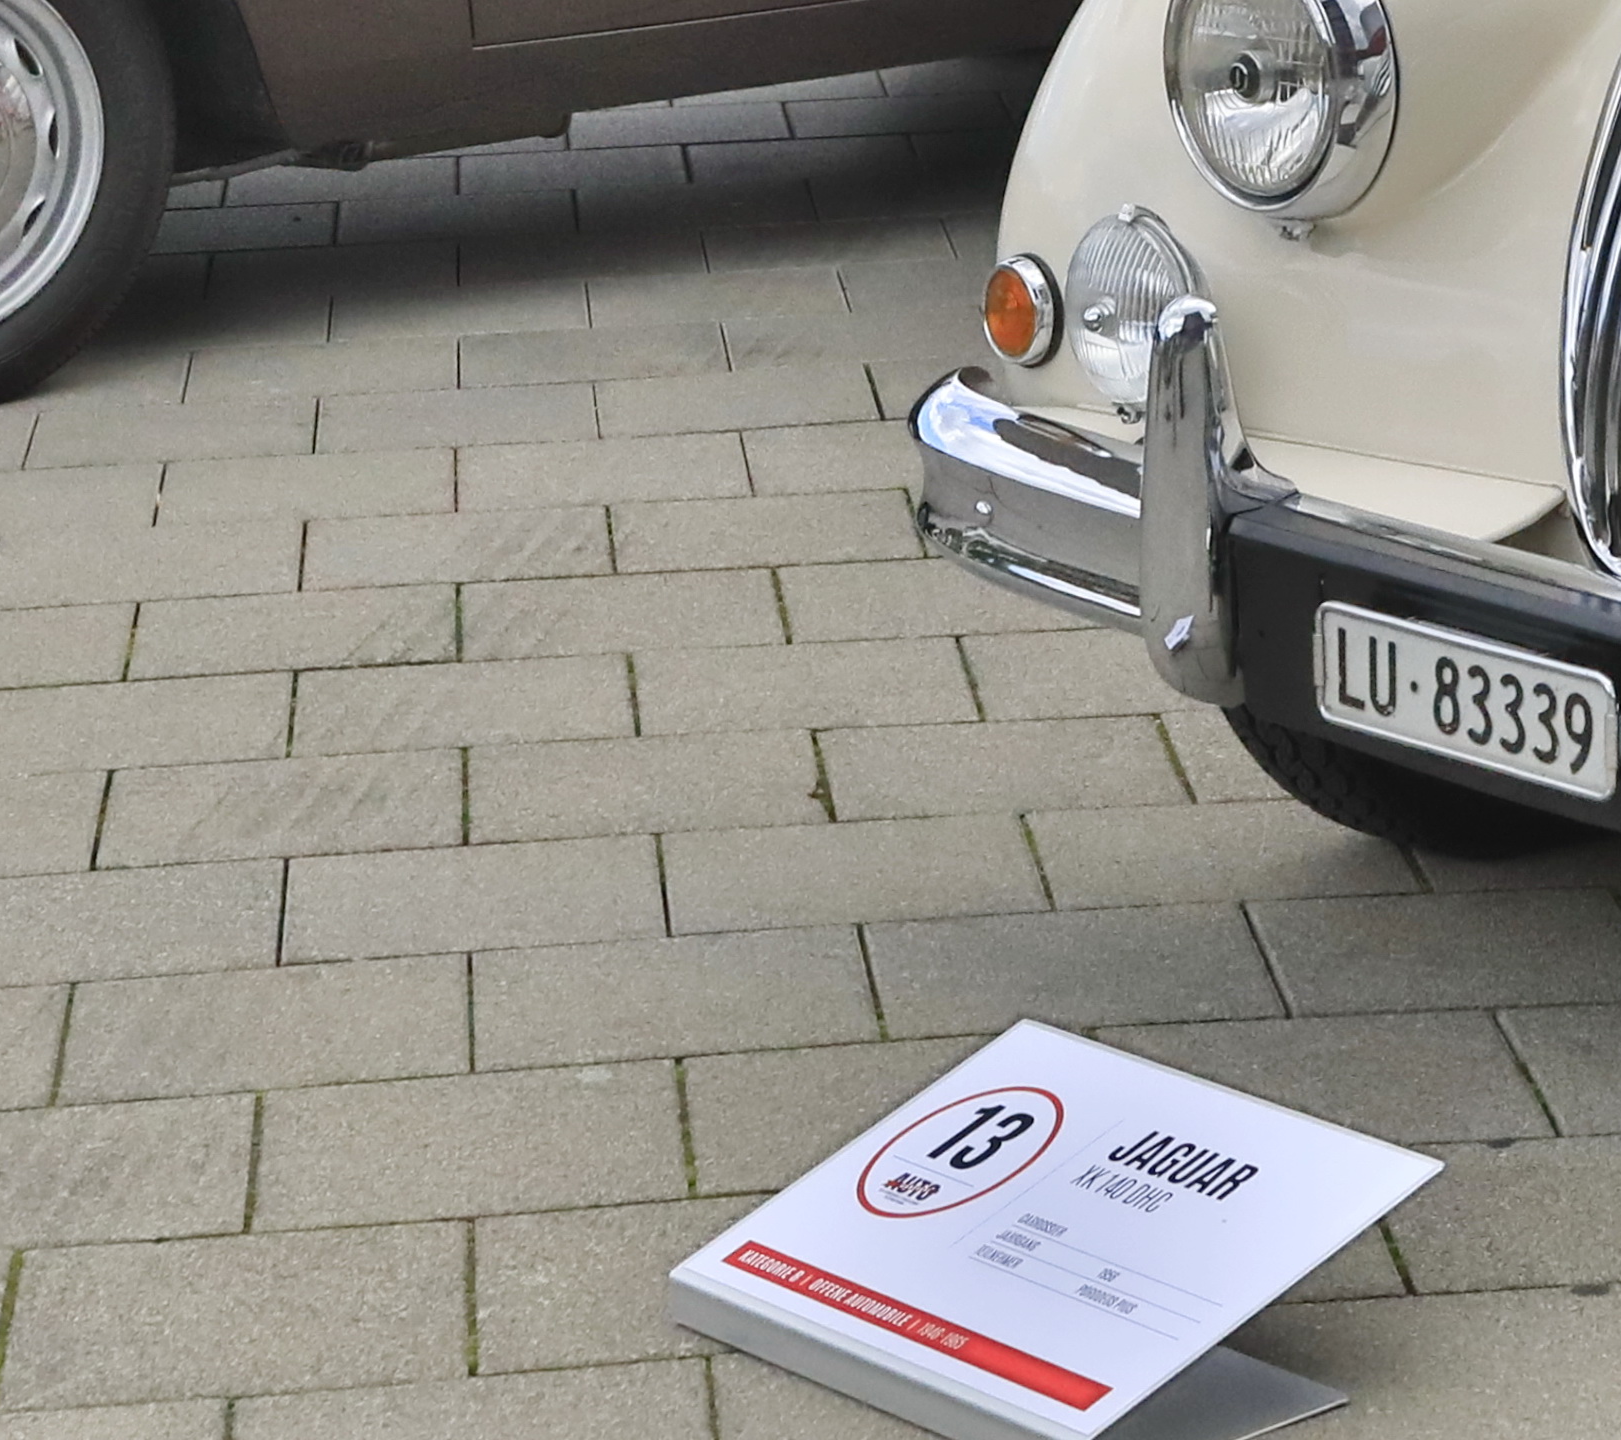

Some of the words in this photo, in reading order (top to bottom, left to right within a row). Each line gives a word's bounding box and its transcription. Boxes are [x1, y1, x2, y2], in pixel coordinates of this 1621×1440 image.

[926, 1104, 1035, 1170] 13
[1108, 1130, 1259, 1200] JAGUAR
[1070, 1164, 1110, 1190] XK
[1094, 1172, 1137, 1200] 140
[1122, 1183, 1174, 1213] DHC
[737, 1248, 797, 1280] KATEGORIE
[790, 1269, 805, 1283] B
[808, 1277, 851, 1303] OFFENE
[843, 1293, 913, 1328] AUTOMOBILE
